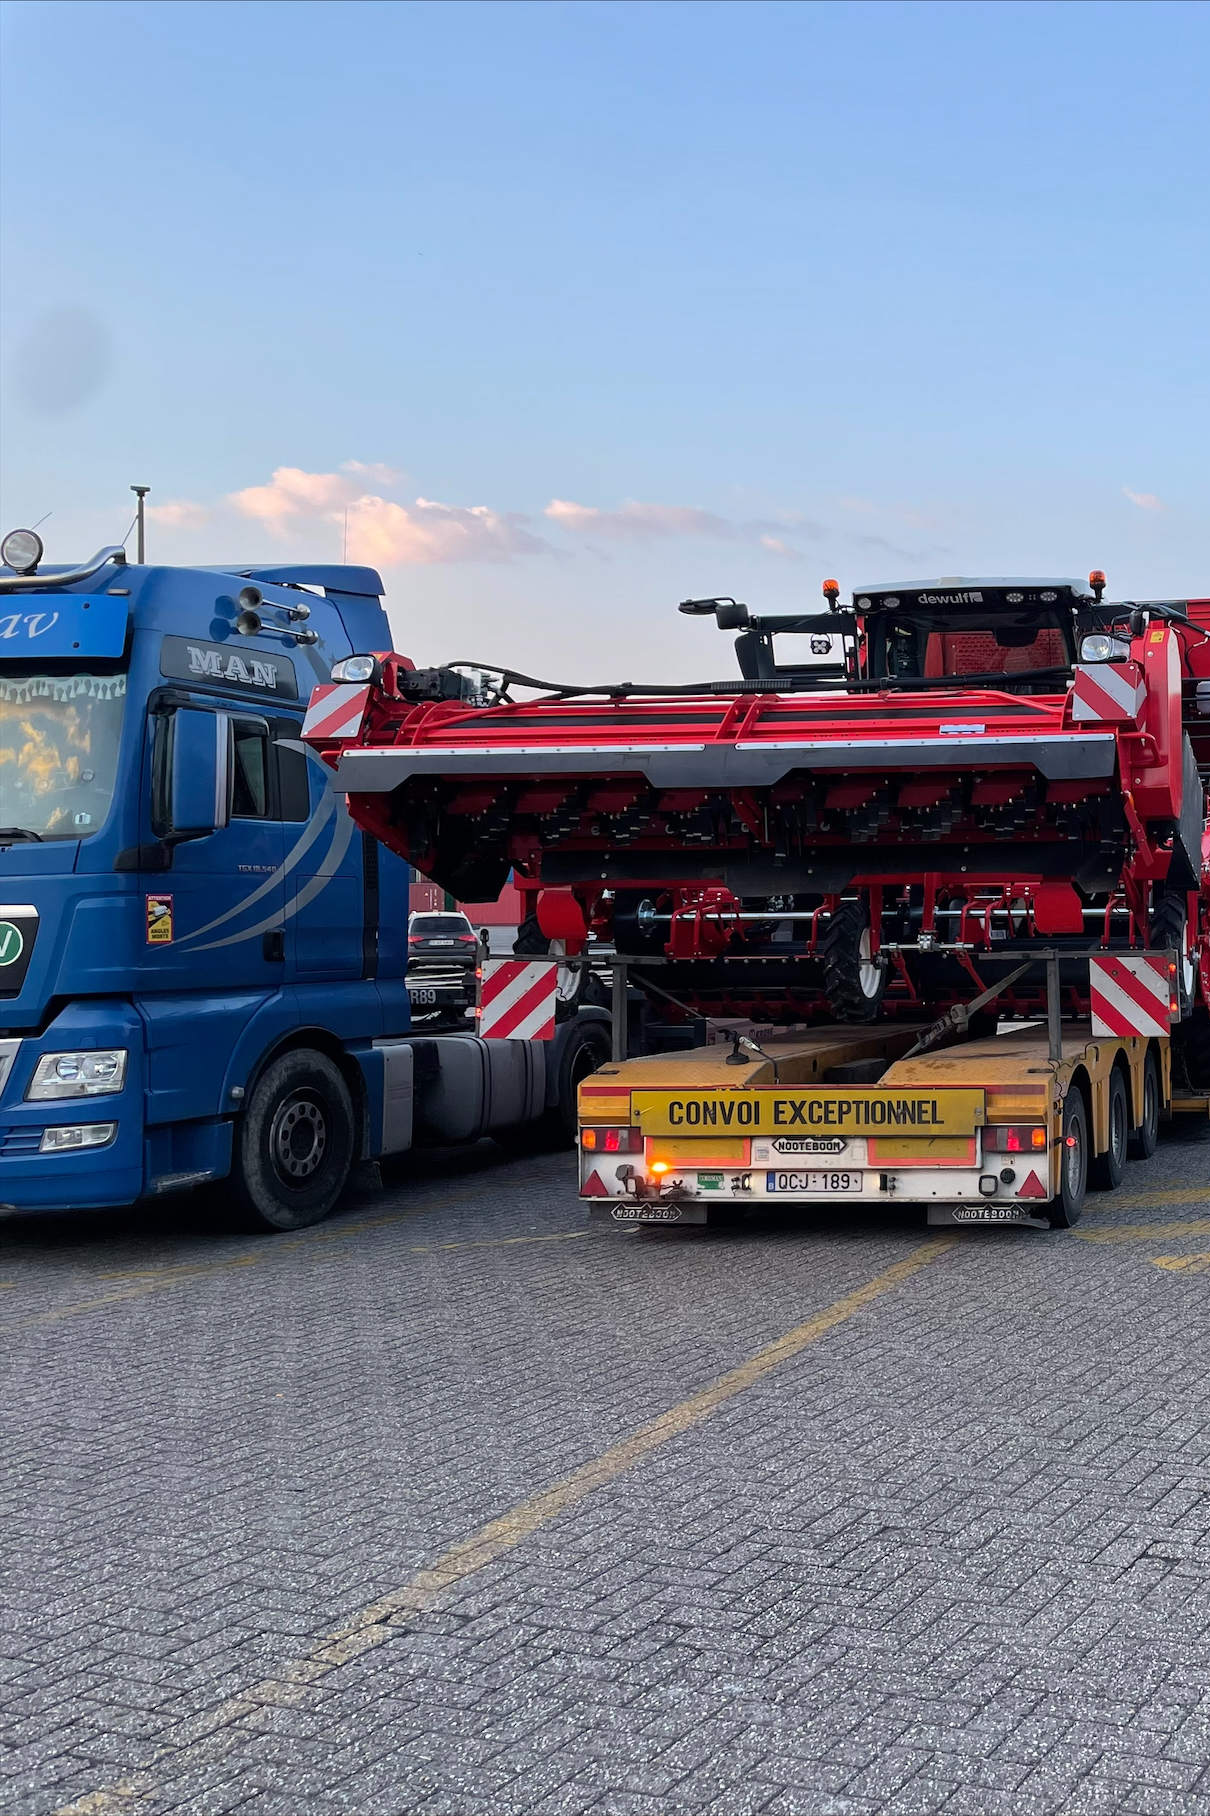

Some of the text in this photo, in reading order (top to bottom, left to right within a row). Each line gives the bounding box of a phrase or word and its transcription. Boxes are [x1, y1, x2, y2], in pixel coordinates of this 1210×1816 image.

[918, 593, 968, 604] dewulf
[187, 646, 277, 689] MAN
[668, 1100, 944, 1125] CONVOI EXCEPTIONNEL
[778, 1142, 840, 1150] NOOTEBOOM
